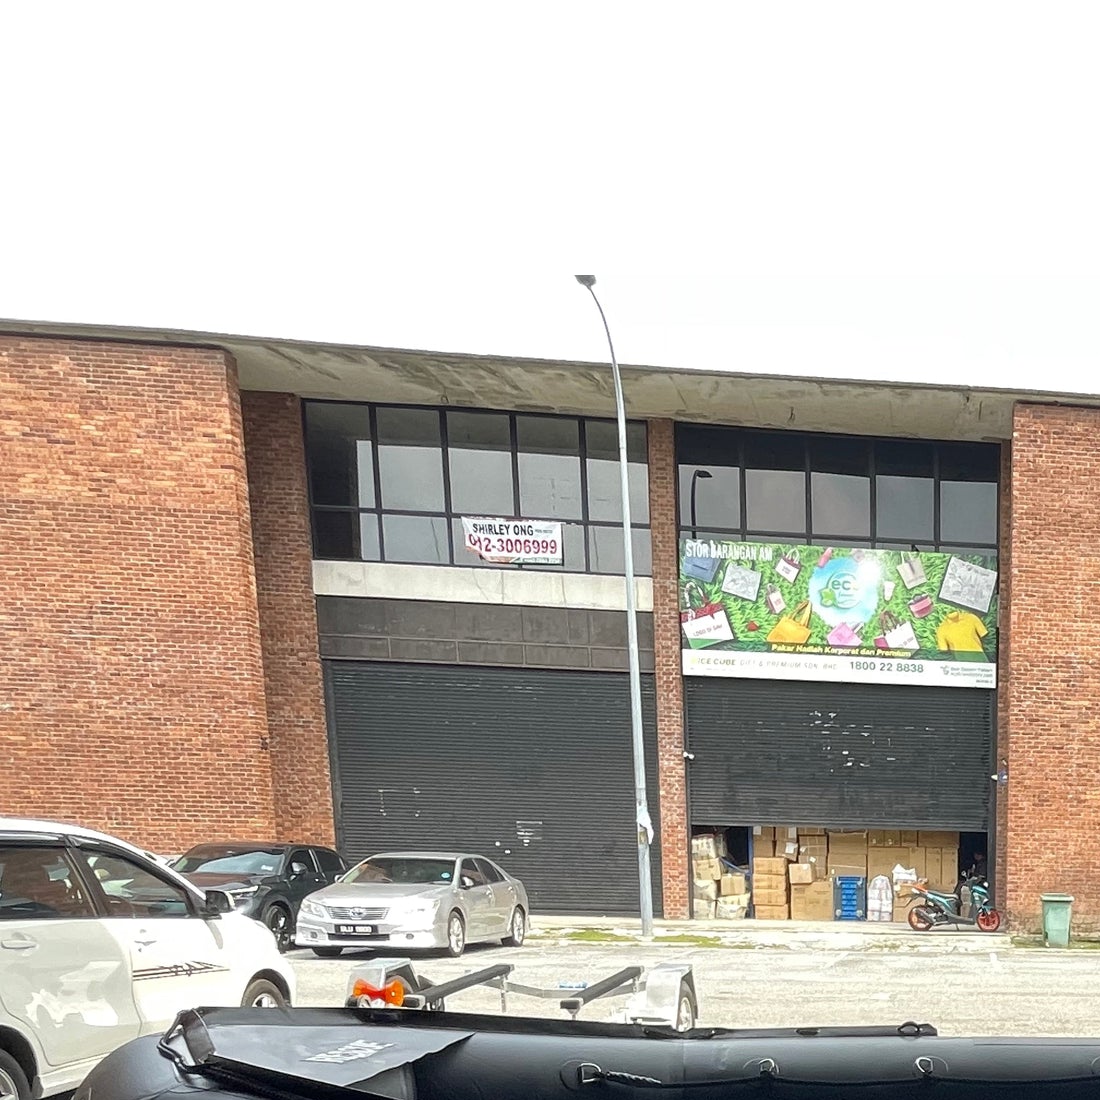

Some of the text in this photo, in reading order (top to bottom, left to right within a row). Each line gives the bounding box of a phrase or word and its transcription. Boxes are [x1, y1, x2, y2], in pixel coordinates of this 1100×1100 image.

[472, 523, 511, 536] SHIRLEY
[513, 525, 534, 536] ONG
[468, 533, 558, 555] 012-3006999
[685, 542, 709, 558] STOR
[759, 546, 773, 560] AM
[771, 643, 912, 658] Pakar Hadiah Korporat dan Premium
[713, 658, 736, 666] CUBE
[850, 661, 924, 673] 1800 22 8838
